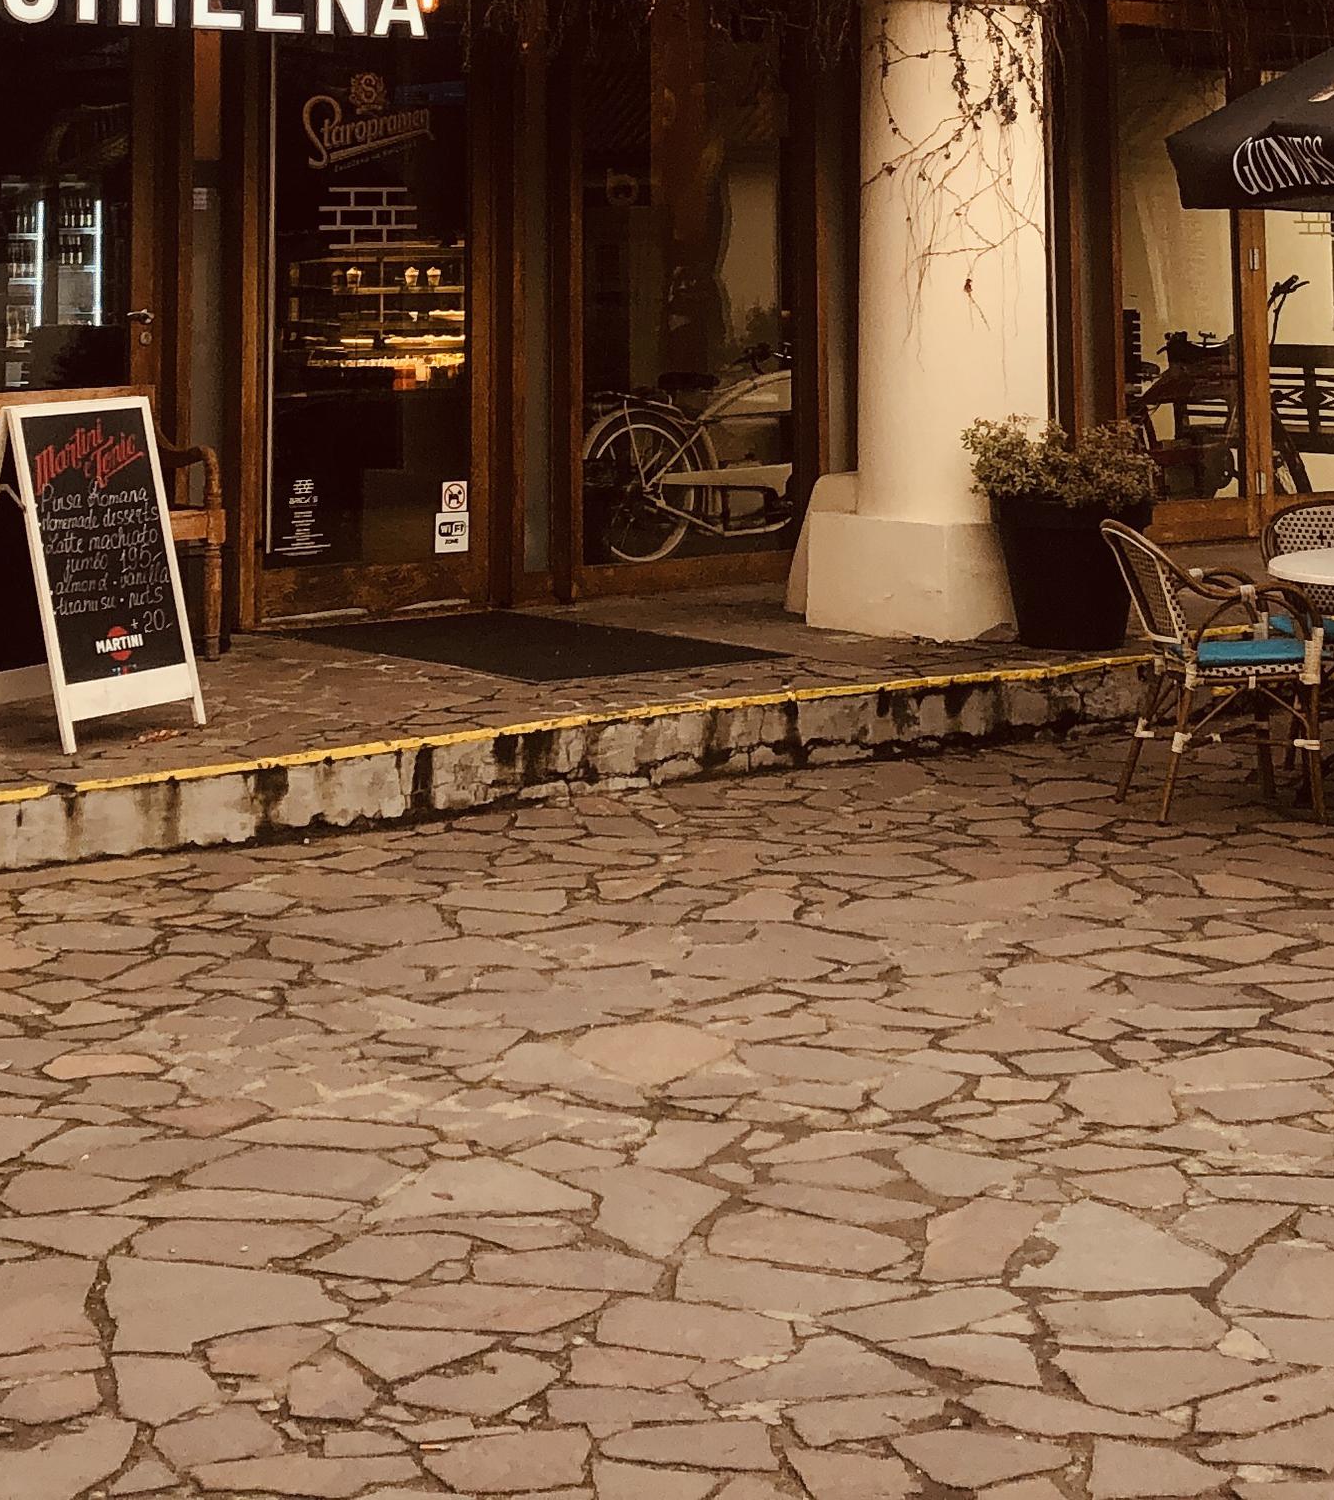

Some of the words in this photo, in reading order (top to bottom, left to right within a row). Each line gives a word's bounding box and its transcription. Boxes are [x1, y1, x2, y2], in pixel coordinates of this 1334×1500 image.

[302, 95, 433, 169] Staropramen
[36, 418, 103, 496] Martini
[129, 584, 163, 609] nuts
[95, 634, 144, 654] MARTINI
